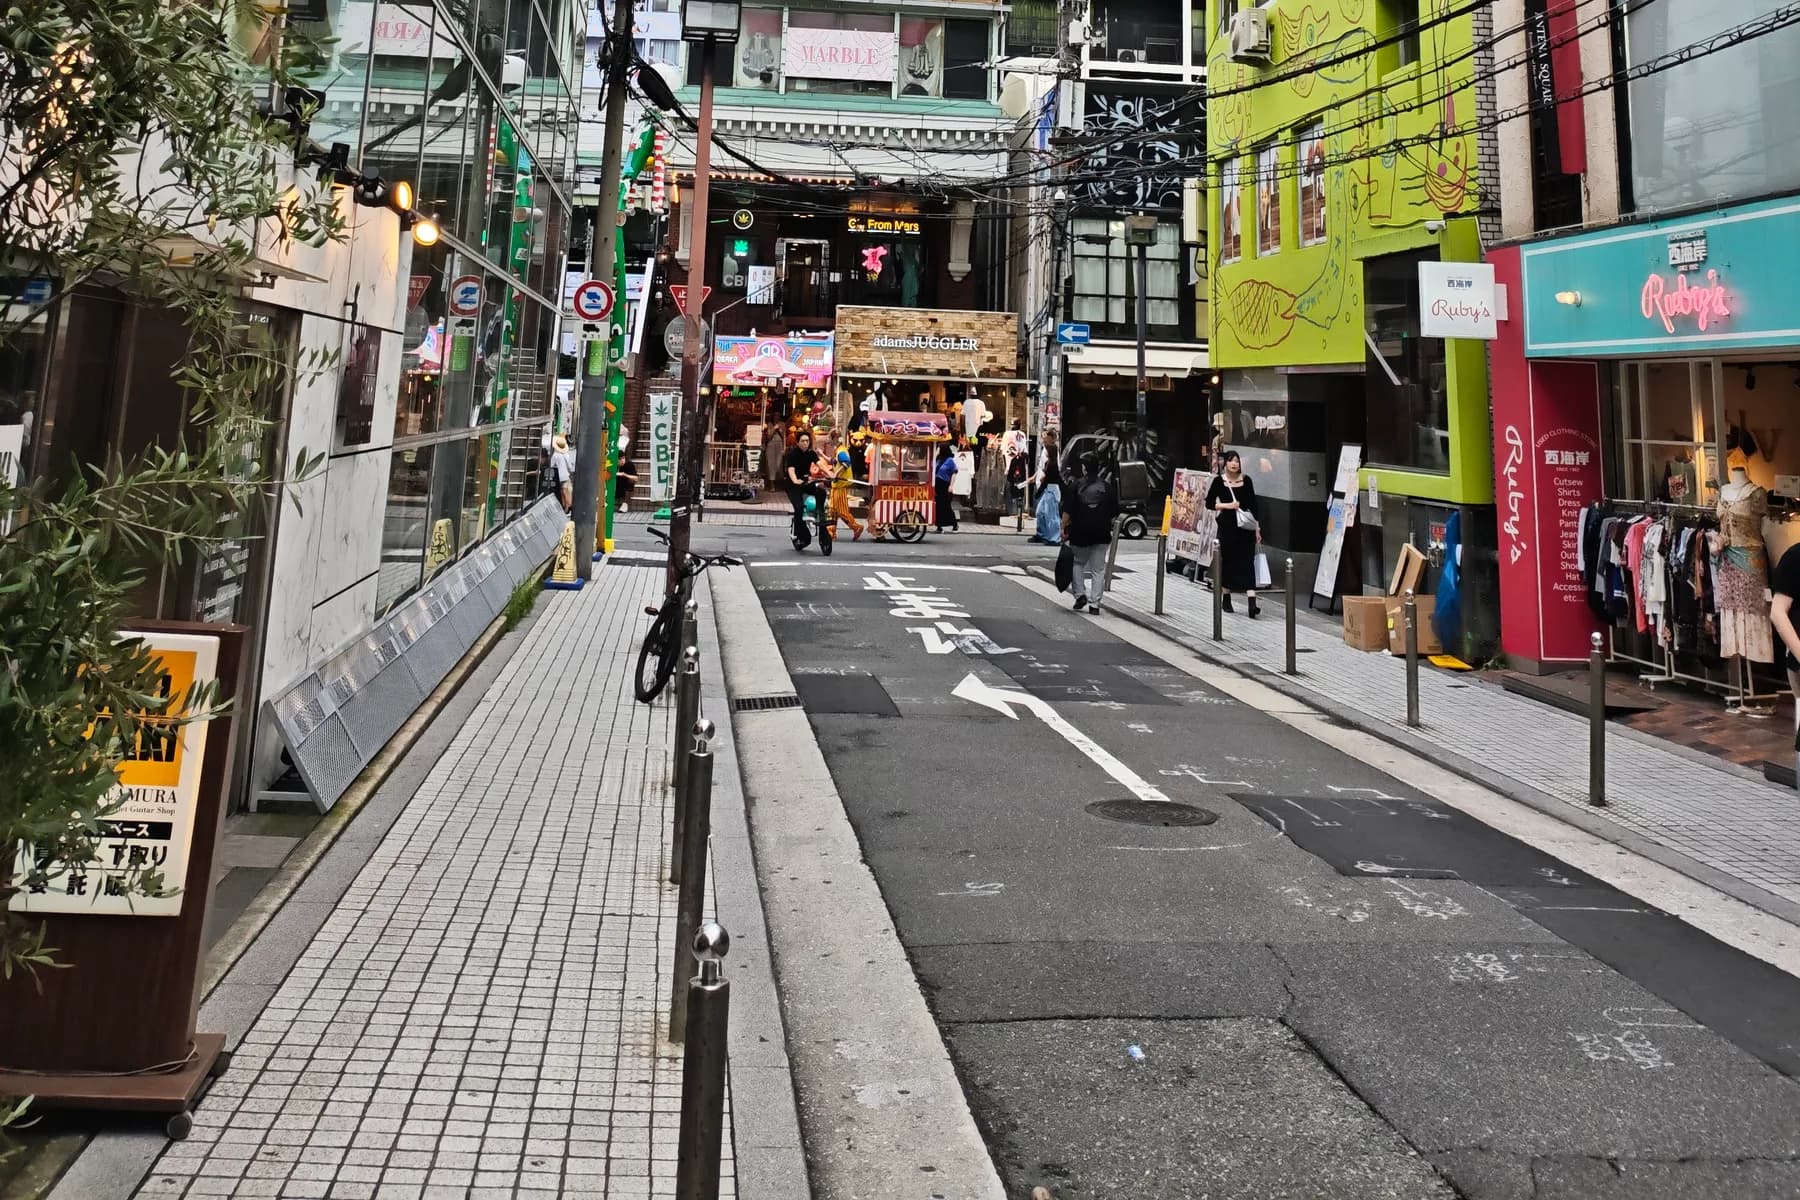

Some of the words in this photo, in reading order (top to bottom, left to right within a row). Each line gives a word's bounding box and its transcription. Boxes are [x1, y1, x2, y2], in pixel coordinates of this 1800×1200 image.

[801, 45, 879, 65] MARBLE
[867, 219, 892, 230] From
[1668, 239, 1707, 265] 西海岸
[723, 274, 748, 287] CB
[1642, 269, 1730, 333] Ruby's
[1431, 299, 1490, 323] Ruby's
[1536, 433, 1550, 448] USED
[1549, 428, 1580, 437] CLOTHING
[1544, 450, 1590, 465] 西海岸
[1553, 477, 1583, 486] Cutsew
[881, 485, 929, 501] POPCORN
[1503, 425, 1528, 564] Ruby's
[1557, 488, 1581, 497] Shirts
[1558, 498, 1581, 507] Dress
[1561, 509, 1578, 518] Knit
[1565, 573, 1580, 581] Hat
[130, 806, 155, 814] Guitar
[156, 806, 176, 816] Shop
